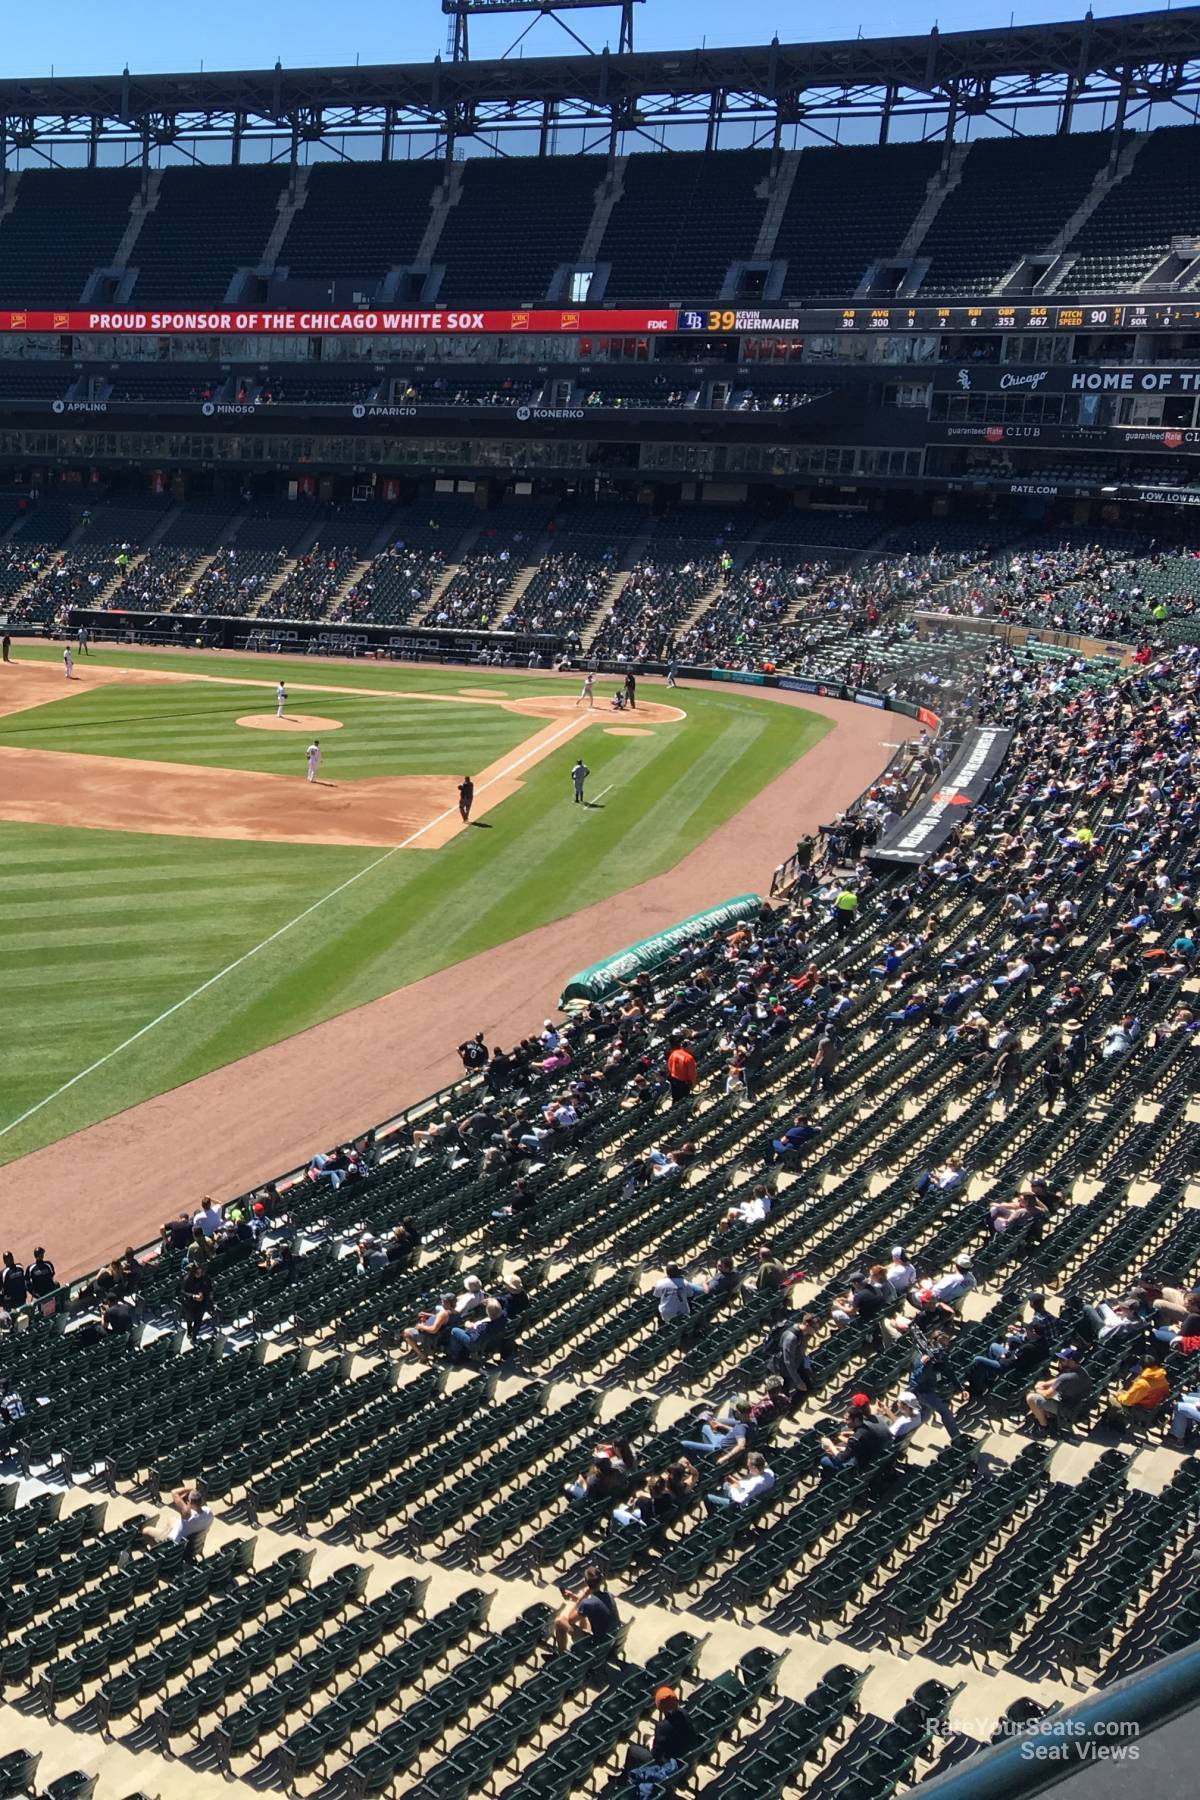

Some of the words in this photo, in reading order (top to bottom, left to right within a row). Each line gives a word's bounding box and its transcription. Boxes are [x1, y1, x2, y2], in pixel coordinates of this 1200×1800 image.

[736, 311, 760, 319] KEVIN
[938, 309, 950, 317] HR
[968, 309, 982, 317] RBI
[1030, 308, 1047, 316] SLG
[1060, 310, 1083, 318] PITCH
[1135, 307, 1145, 315] TB
[90, 314, 146, 328] PROUD
[151, 314, 231, 329] SPONSOR
[236, 314, 258, 329] OF
[263, 315, 295, 328] THE
[300, 314, 378, 329] CHICAGO
[383, 314, 442, 328] WHITE
[447, 313, 484, 329] SOX
[684, 312, 702, 329] TB
[707, 311, 735, 330] 39
[1091, 310, 1107, 323] 90
[1163, 317, 1170, 325] 0
[648, 320, 668, 329] FDIC
[735, 318, 799, 330] KIERMAIER
[842, 319, 854, 327] 30
[869, 319, 889, 328] .300
[908, 318, 914, 327] 9
[939, 318, 946, 327] 2
[970, 318, 977, 327] 6
[994, 317, 1015, 327] .353
[1027, 317, 1047, 326] .667
[1059, 318, 1083, 326] SPEED
[1130, 318, 1148, 326] SOX
[1000, 370, 1048, 389] Chicago
[1071, 374, 1133, 389] HOME
[1141, 374, 1172, 390] OF
[67, 403, 107, 412] APPLING
[217, 404, 255, 414] MINOSO
[368, 407, 417, 416] APARICIO
[533, 409, 584, 418] KONERKO
[948, 427, 986, 436] guaranteed
[986, 428, 1004, 436] Rate
[1006, 427, 1041, 437] CLUB
[1125, 432, 1165, 441] guaranteed
[1165, 432, 1182, 441] Rate
[1011, 485, 1058, 495] RATE.COM
[1140, 491, 1164, 501] LOW,
[1167, 493, 1187, 502] LOW
[250, 628, 298, 641] GEICO
